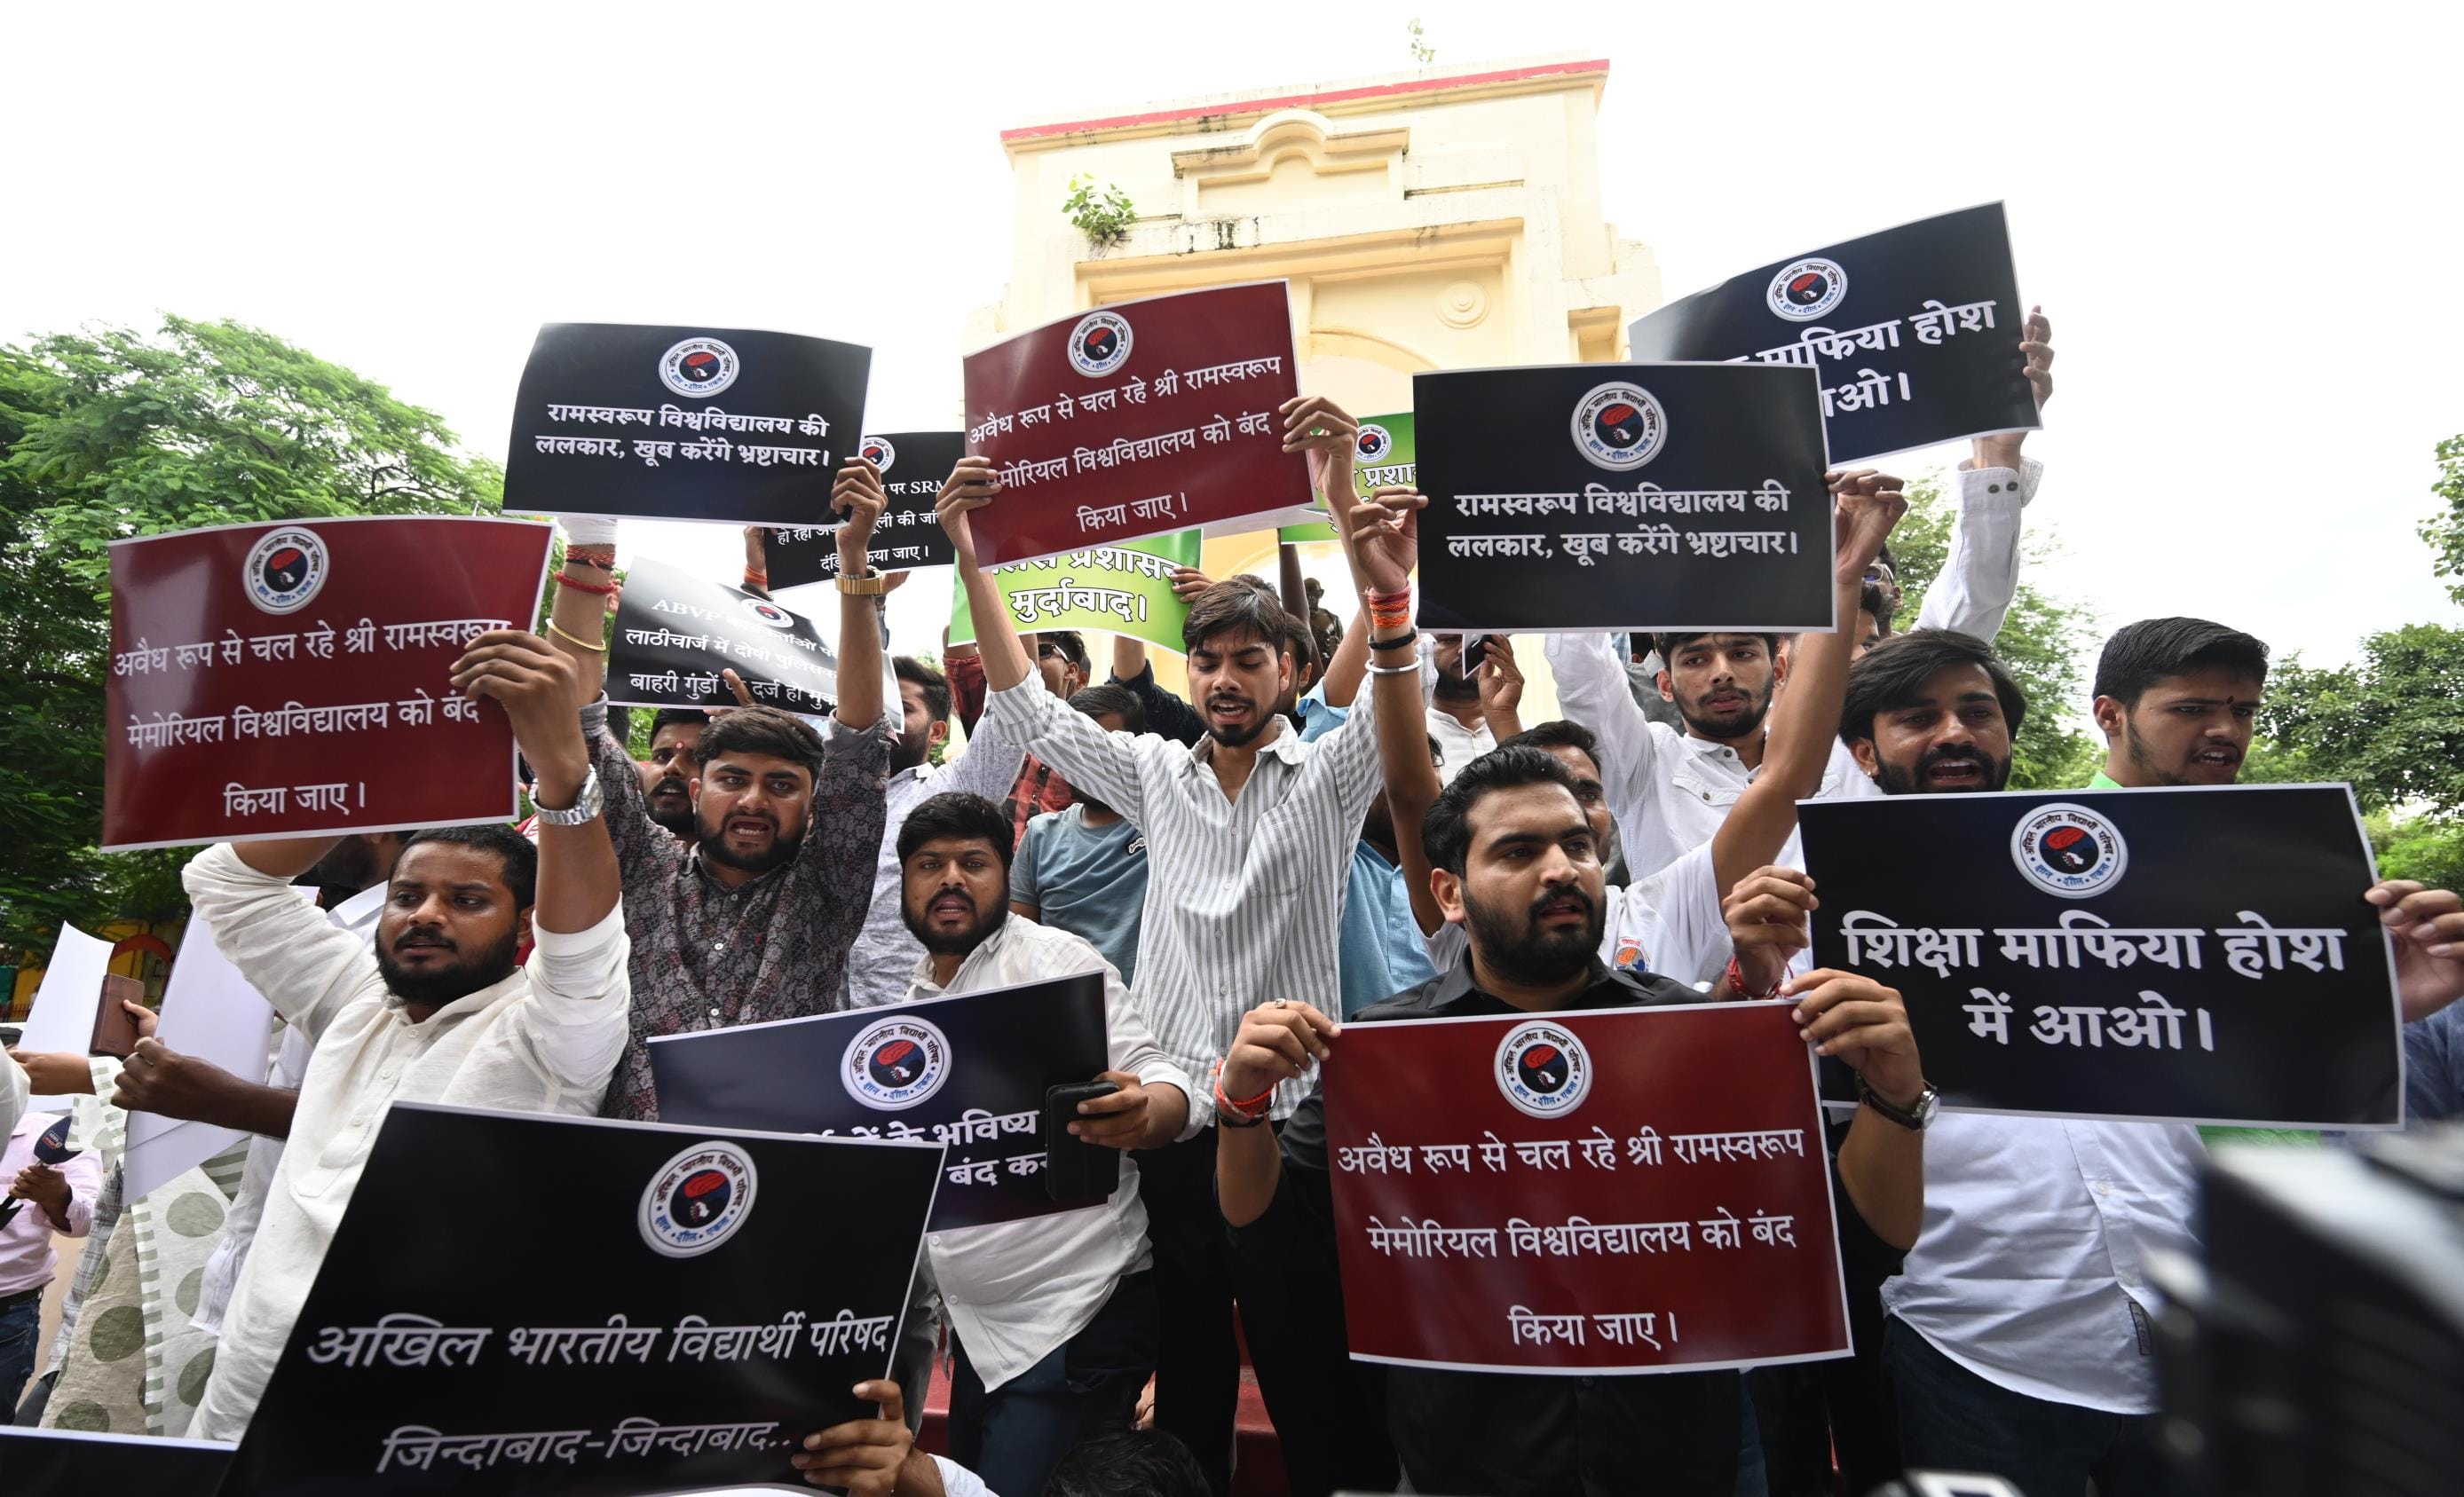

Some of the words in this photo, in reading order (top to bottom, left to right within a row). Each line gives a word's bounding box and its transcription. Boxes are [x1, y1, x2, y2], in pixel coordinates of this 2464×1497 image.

[1907, 299, 1997, 345] होश
[547, 404, 655, 426] रामस्वरूप
[659, 403, 794, 435] विश्वविद्यालय
[797, 413, 830, 437] की
[969, 412, 1014, 445] अवैध
[1018, 404, 1051, 429] रूप
[1054, 392, 1075, 420] से
[1078, 388, 1117, 413] चल
[1121, 375, 1147, 405] रहे
[1154, 368, 1179, 398] श्री
[1183, 356, 1282, 390] रामस्वरूप
[534, 435, 626, 459] ललकार,
[632, 439, 676, 467] खूब
[680, 436, 733, 461] करेंगे
[738, 445, 830, 467] भ्रष्टाचार।
[1072, 428, 1196, 474] विश्वविद्यालय
[1200, 414, 1230, 445] को
[1236, 411, 1272, 436] बंद
[888, 482, 906, 495] पर
[1453, 492, 1579, 517] रामस्वरूप
[1583, 481, 1747, 517] विश्वविद्यालय
[1752, 478, 1791, 512] की
[896, 509, 917, 526] की
[920, 509, 938, 524] जां
[1076, 503, 1127, 532] किया
[1446, 534, 1553, 559] ललकार,
[1560, 532, 1612, 566] खूब
[1615, 523, 1681, 555] करेंगे
[1685, 531, 1797, 558] भ्रष्टाचार।
[651, 598, 721, 622] ABVP
[1009, 577, 1148, 623] मुर्दाबाद।
[114, 636, 169, 677] अवैध
[174, 641, 214, 672] रूप
[220, 628, 244, 665] से
[249, 634, 297, 661] चल
[304, 619, 336, 658] रहे
[344, 617, 376, 653] श्री
[625, 627, 710, 651] लाठीचार्ज
[713, 636, 731, 654] में
[734, 642, 770, 662] दोषी
[629, 669, 678, 693] बाहरी
[684, 671, 718, 700] गुंडों
[751, 678, 780, 699] दर्ज
[785, 681, 804, 703] हो
[127, 712, 225, 750] मेमोरियल
[232, 701, 390, 740] विश्वविद्यालय
[397, 688, 435, 727] को
[441, 689, 480, 723] बंद
[223, 782, 288, 817] किया
[1839, 910, 1984, 979] शिक्षा
[1994, 909, 2205, 970] माफिया
[2215, 910, 2348, 980] होश
[1962, 987, 2013, 1045] में
[932, 1109, 1040, 1146] भविष्य
[1337, 1131, 1413, 1175] अवैध
[1418, 1144, 1472, 1174] रूप
[1477, 1131, 1507, 1172] से
[1512, 1139, 1571, 1170] चल
[1576, 1125, 1615, 1171] रहे
[1626, 1125, 1662, 1166] श्री
[1668, 1128, 1805, 1164] रामस्वरूप
[945, 1156, 1000, 1186] बंद
[1365, 1215, 1498, 1258] मेमोरियल
[1505, 1215, 1690, 1257] विश्वविद्यालय
[1697, 1206, 1741, 1250] को
[1747, 1209, 1797, 1249] बंद
[306, 1312, 494, 1367] अखिल
[507, 1313, 662, 1365] भारतीय
[667, 1311, 806, 1362] विद्यार्थी
[809, 1309, 894, 1358] परिषद
[1506, 1304, 1586, 1346] किया
